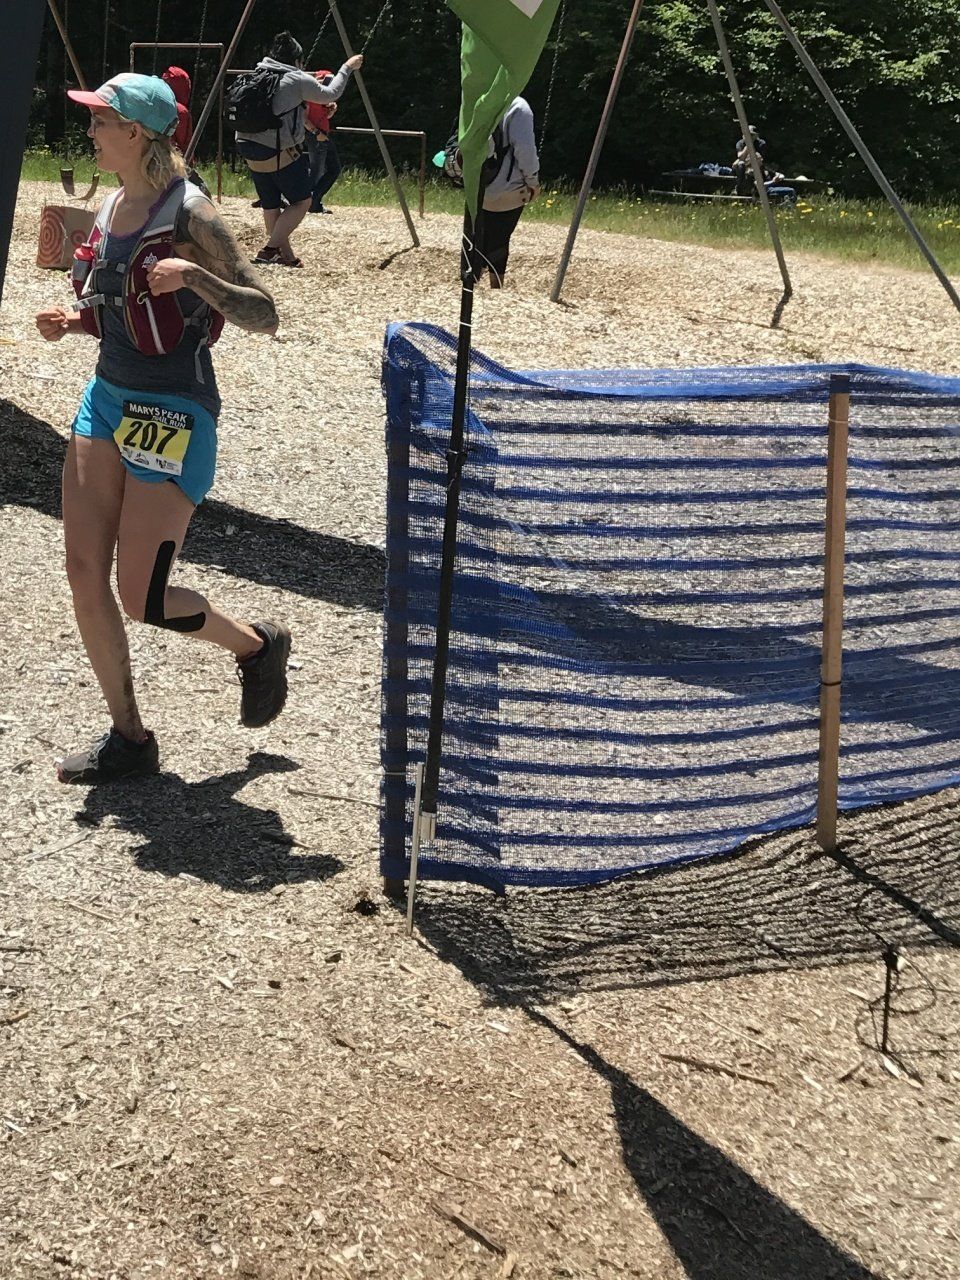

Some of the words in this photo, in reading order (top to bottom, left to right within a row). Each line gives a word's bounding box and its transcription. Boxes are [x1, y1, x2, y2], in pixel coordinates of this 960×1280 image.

[129, 403, 160, 416] MARYS
[161, 409, 187, 423] PEAK
[169, 420, 186, 429] RUN
[123, 421, 178, 455] 207
